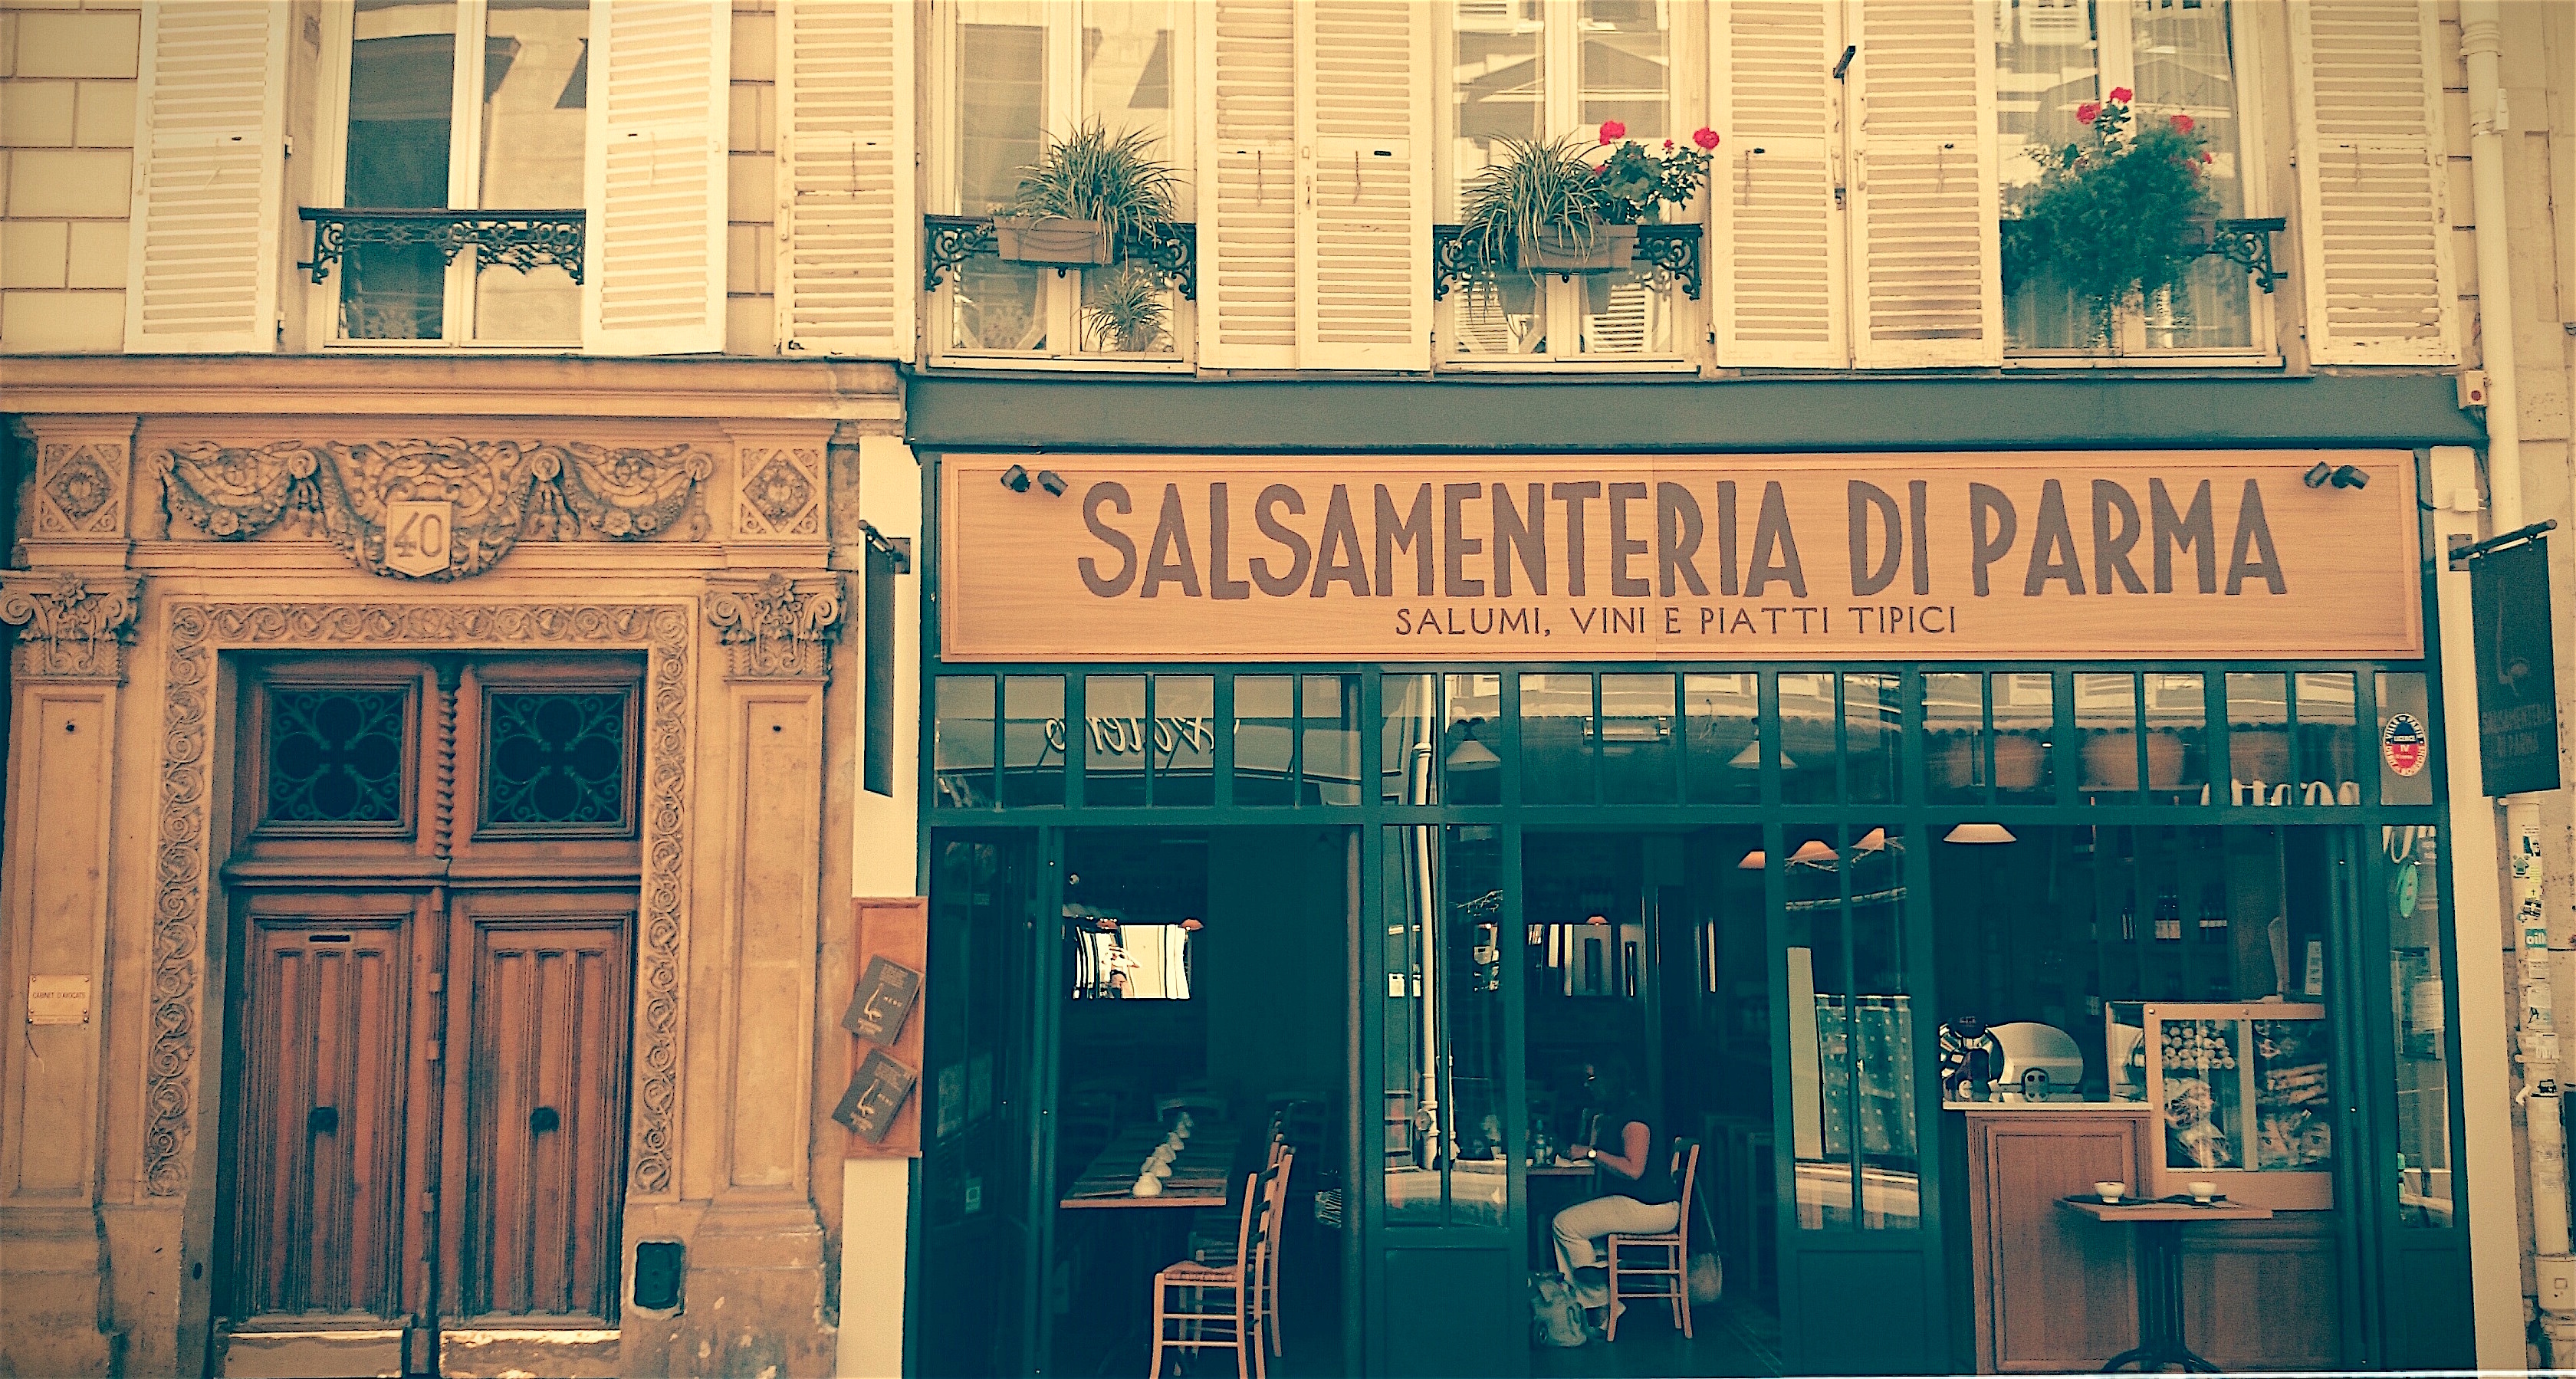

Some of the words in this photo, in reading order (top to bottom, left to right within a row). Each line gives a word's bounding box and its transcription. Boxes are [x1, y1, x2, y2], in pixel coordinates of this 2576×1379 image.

[393, 511, 442, 557] 40
[1077, 480, 1808, 600] SALSAMENTERIA
[1847, 479, 1930, 596] DI
[1969, 478, 2288, 598] PARMA
[1395, 607, 1550, 637] SALUMI,
[1569, 606, 1644, 635] VINI
[1664, 606, 1681, 635] E
[1700, 606, 1829, 635] PIATTI
[1848, 606, 1955, 634] TIPICI
